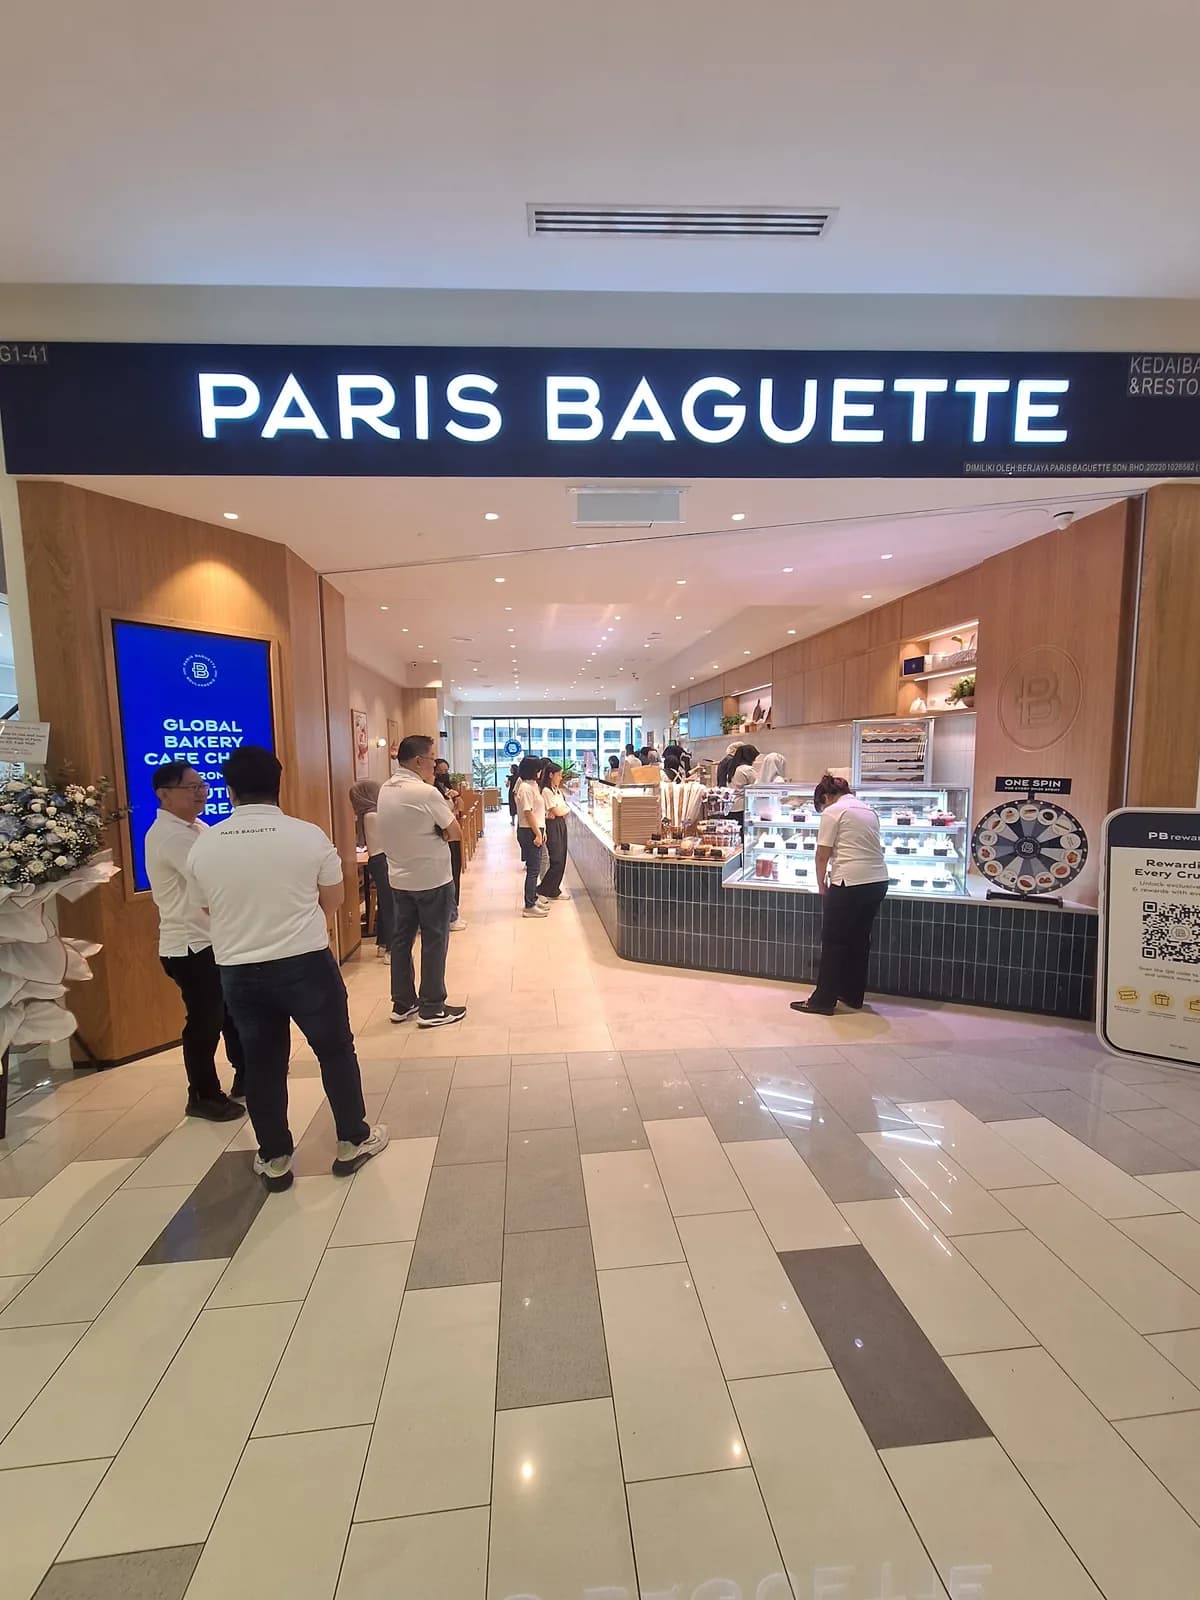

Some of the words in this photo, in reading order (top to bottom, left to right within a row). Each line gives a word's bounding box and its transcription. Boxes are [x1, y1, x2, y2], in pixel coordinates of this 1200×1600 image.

[0, 345, 47, 362] G1-41
[198, 372, 502, 442] PARIS
[546, 376, 1070, 444] BAGUETTE
[1050, 463, 1071, 472] PARIS
[1072, 463, 1111, 472] BAGUETTE
[163, 719, 243, 732] GLOBAL
[164, 736, 244, 748] BAKERY
[144, 752, 200, 765] CAFE
[1148, 832, 1169, 840] PB
[1135, 869, 1171, 879] Every
